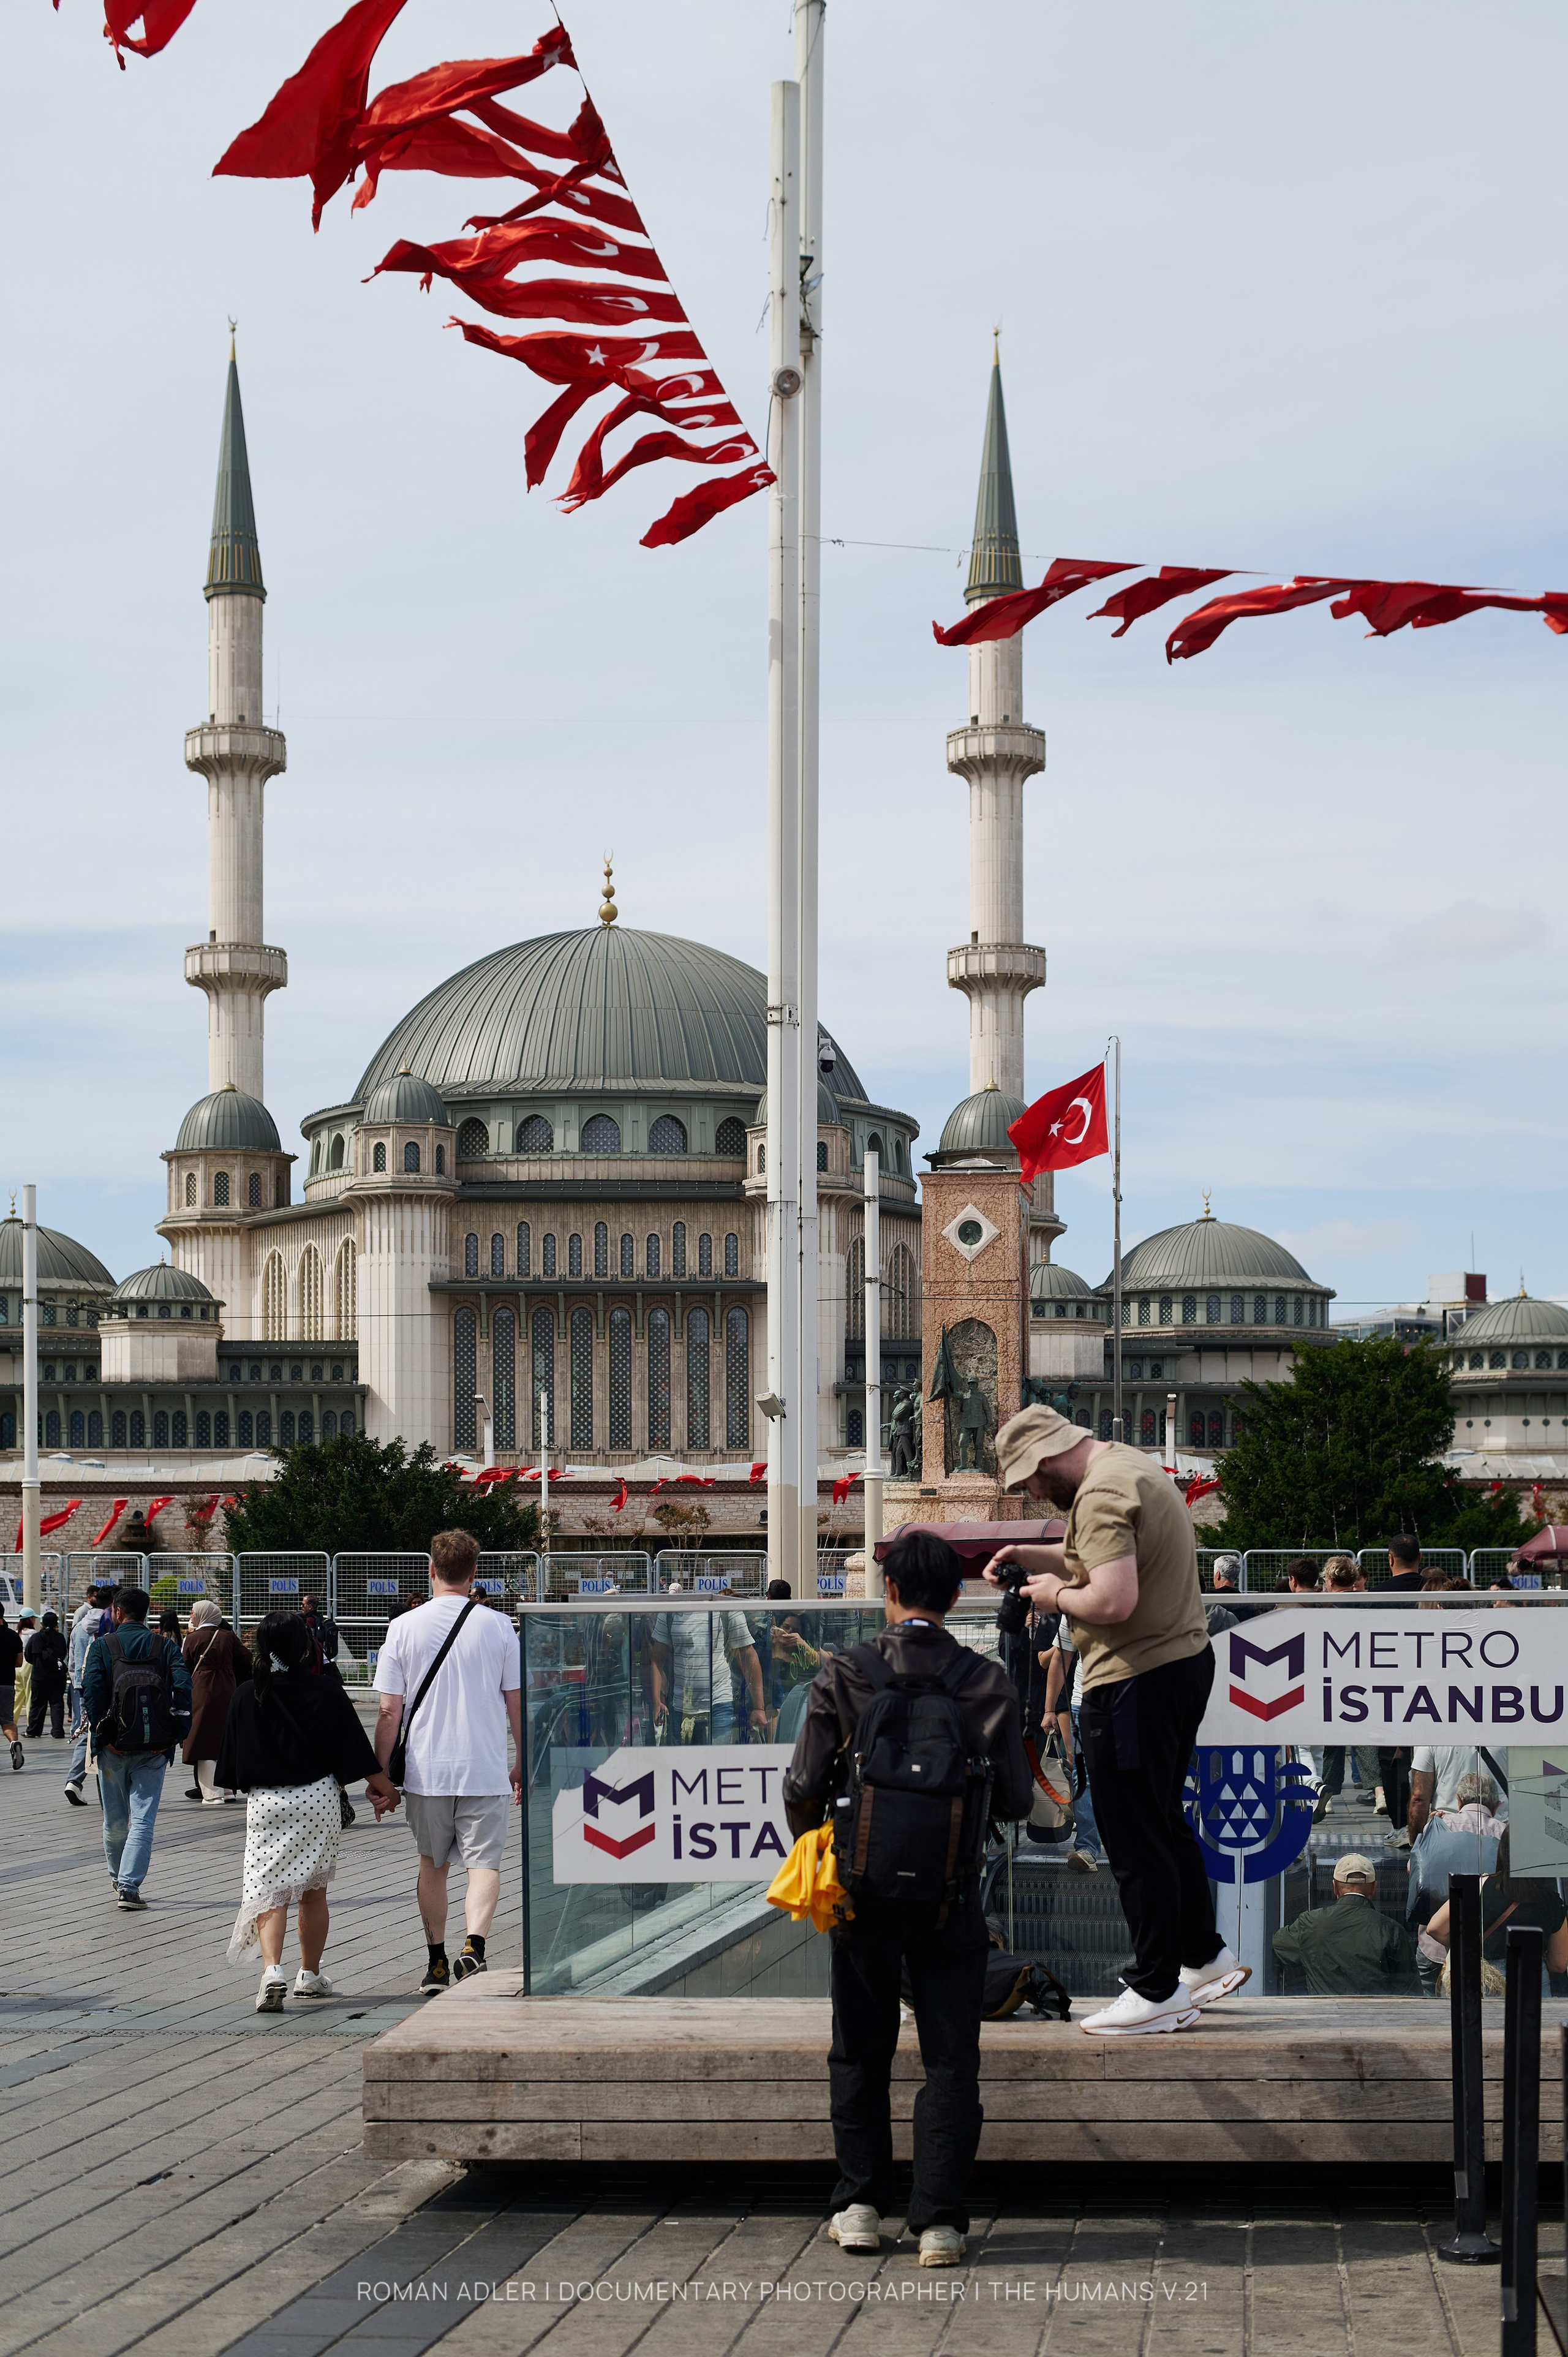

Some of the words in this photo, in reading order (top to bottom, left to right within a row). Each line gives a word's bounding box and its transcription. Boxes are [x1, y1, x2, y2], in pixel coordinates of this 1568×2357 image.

[179, 1579, 203, 1592] POLİS
[272, 1578, 296, 1591] POLİS
[370, 1580, 396, 1593] POLİS
[582, 1578, 610, 1592] POLİS
[698, 1577, 728, 1591] POLİS
[1323, 1630, 1519, 1668] METRO
[1323, 1677, 1564, 1723] İSTANBU
[672, 1768, 790, 1806] MET
[673, 1814, 797, 1860] İSTA
